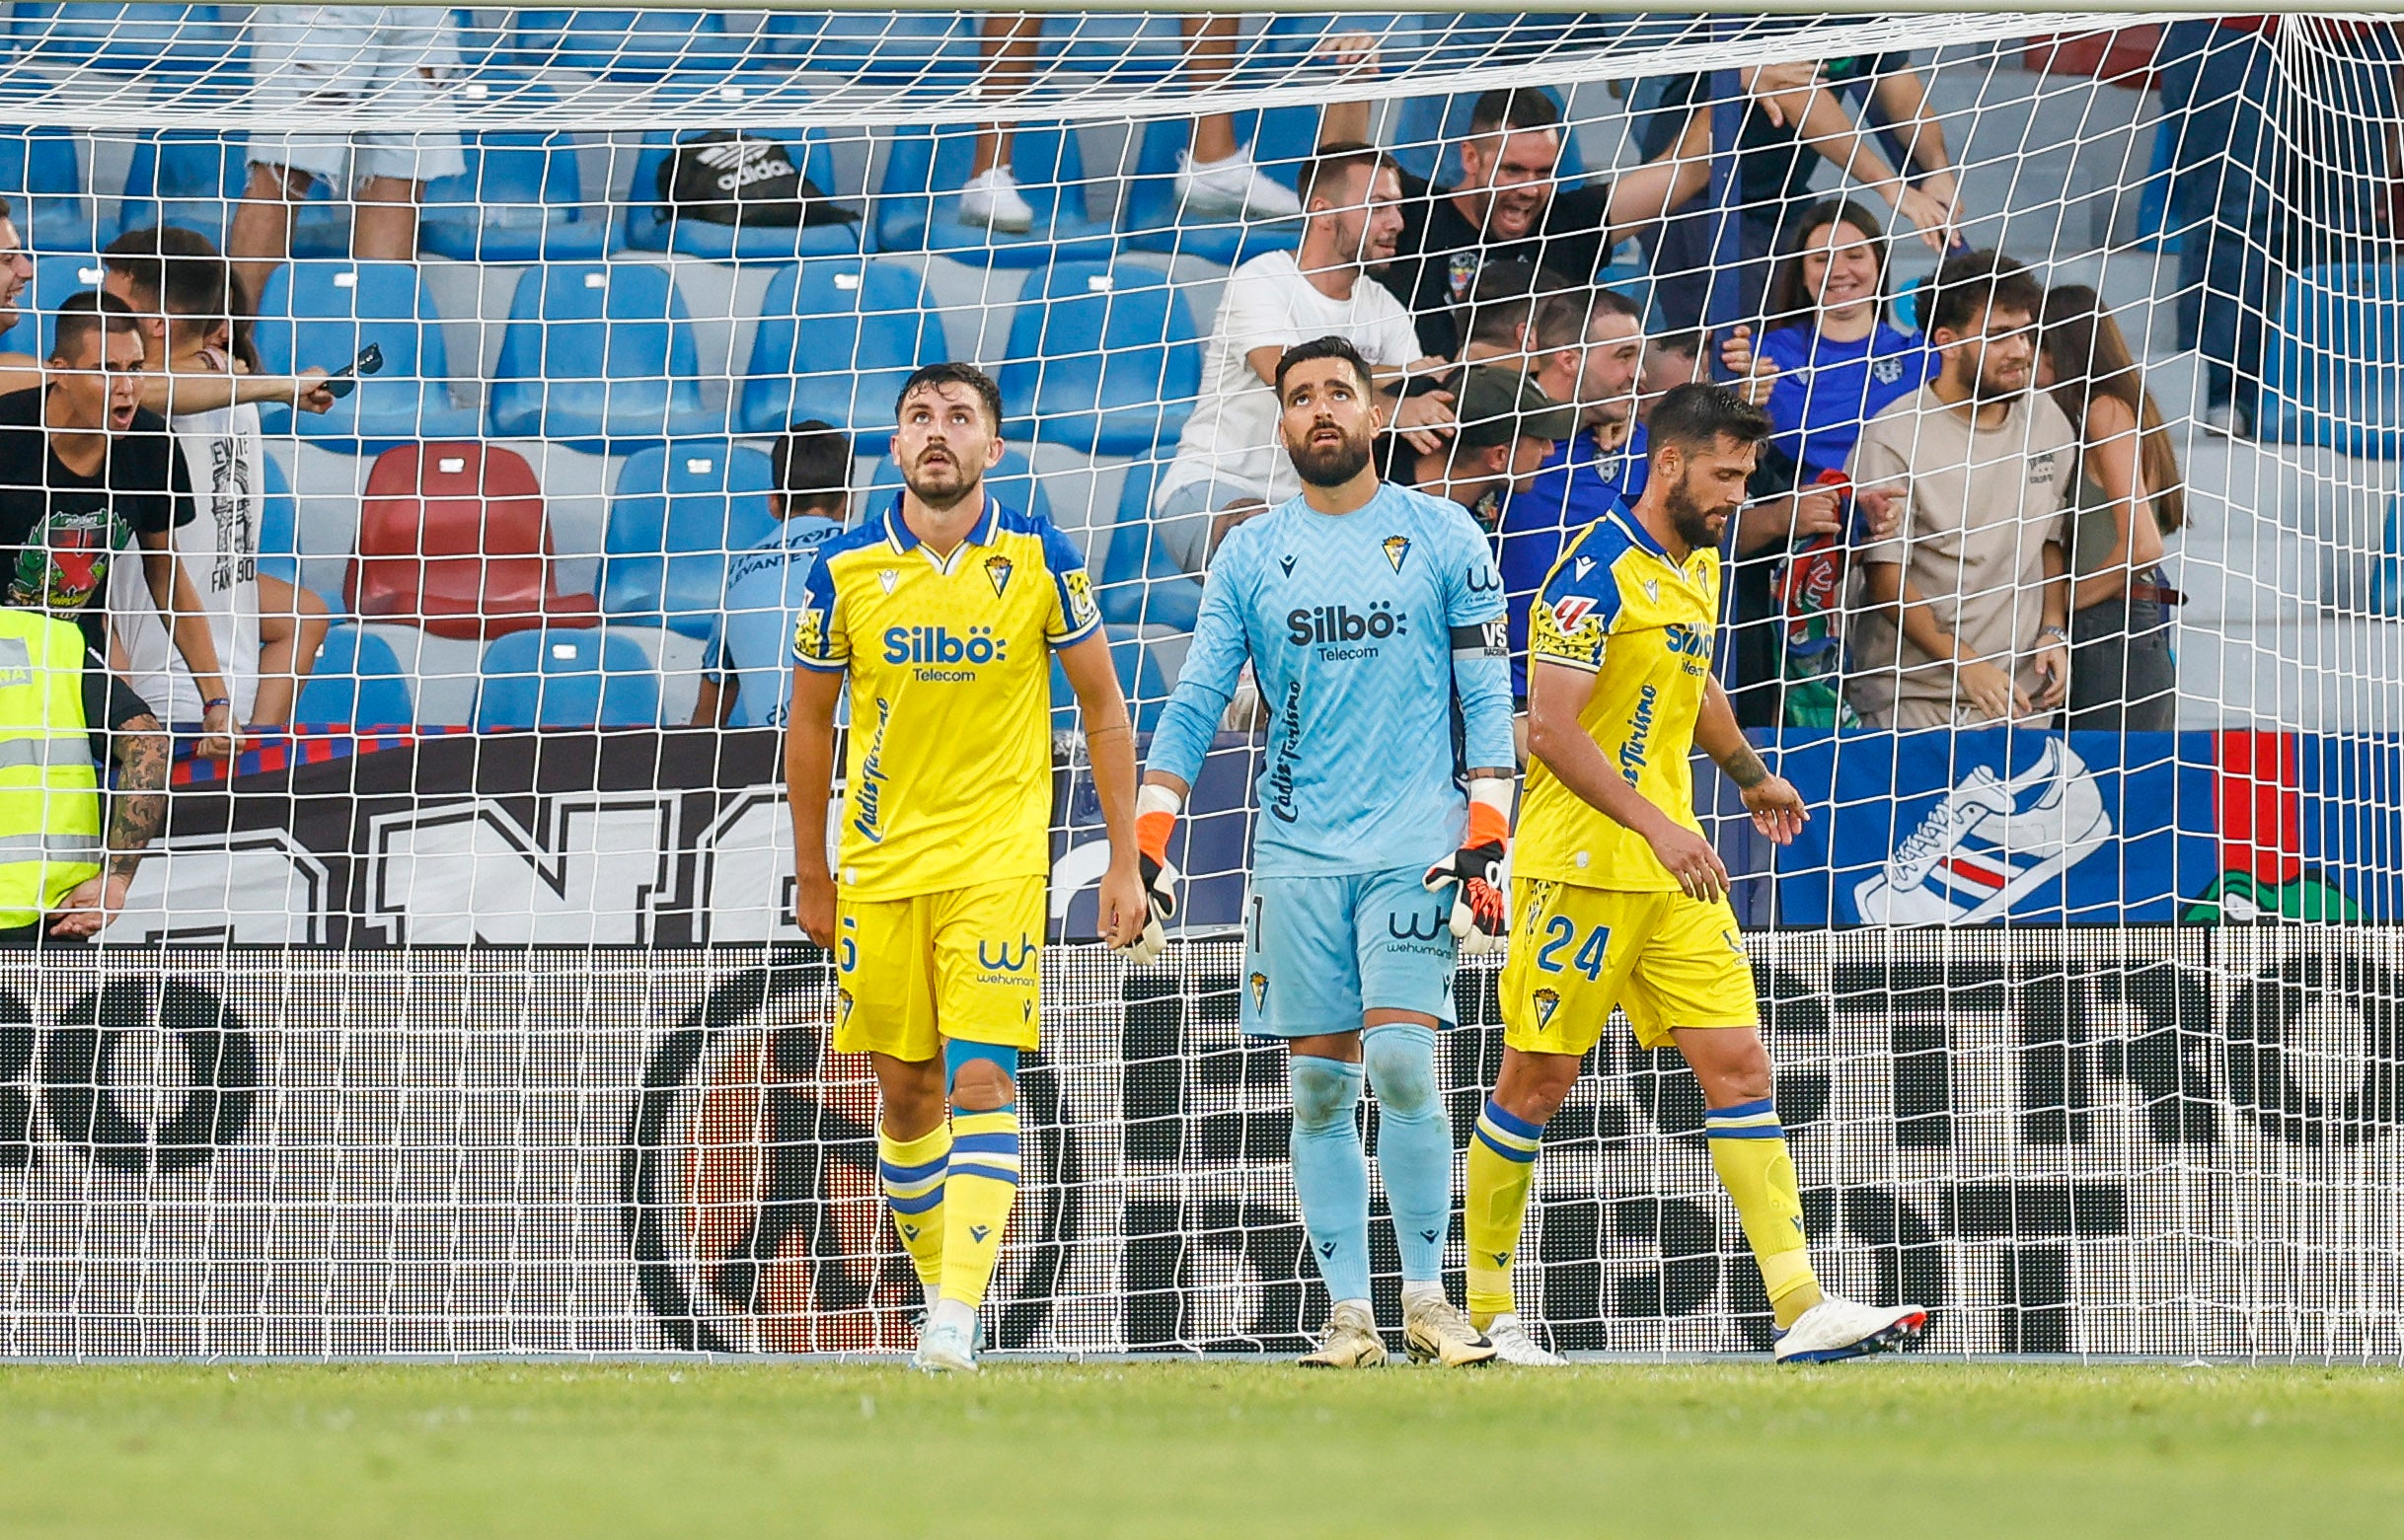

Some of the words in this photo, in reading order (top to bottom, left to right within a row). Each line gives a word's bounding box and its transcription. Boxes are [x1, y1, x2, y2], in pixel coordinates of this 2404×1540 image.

[1481, 623, 1508, 648] VS
[1316, 646, 1380, 662] Telecom
[913, 668, 976, 682] Telecom
[1538, 915, 1612, 982] 24
